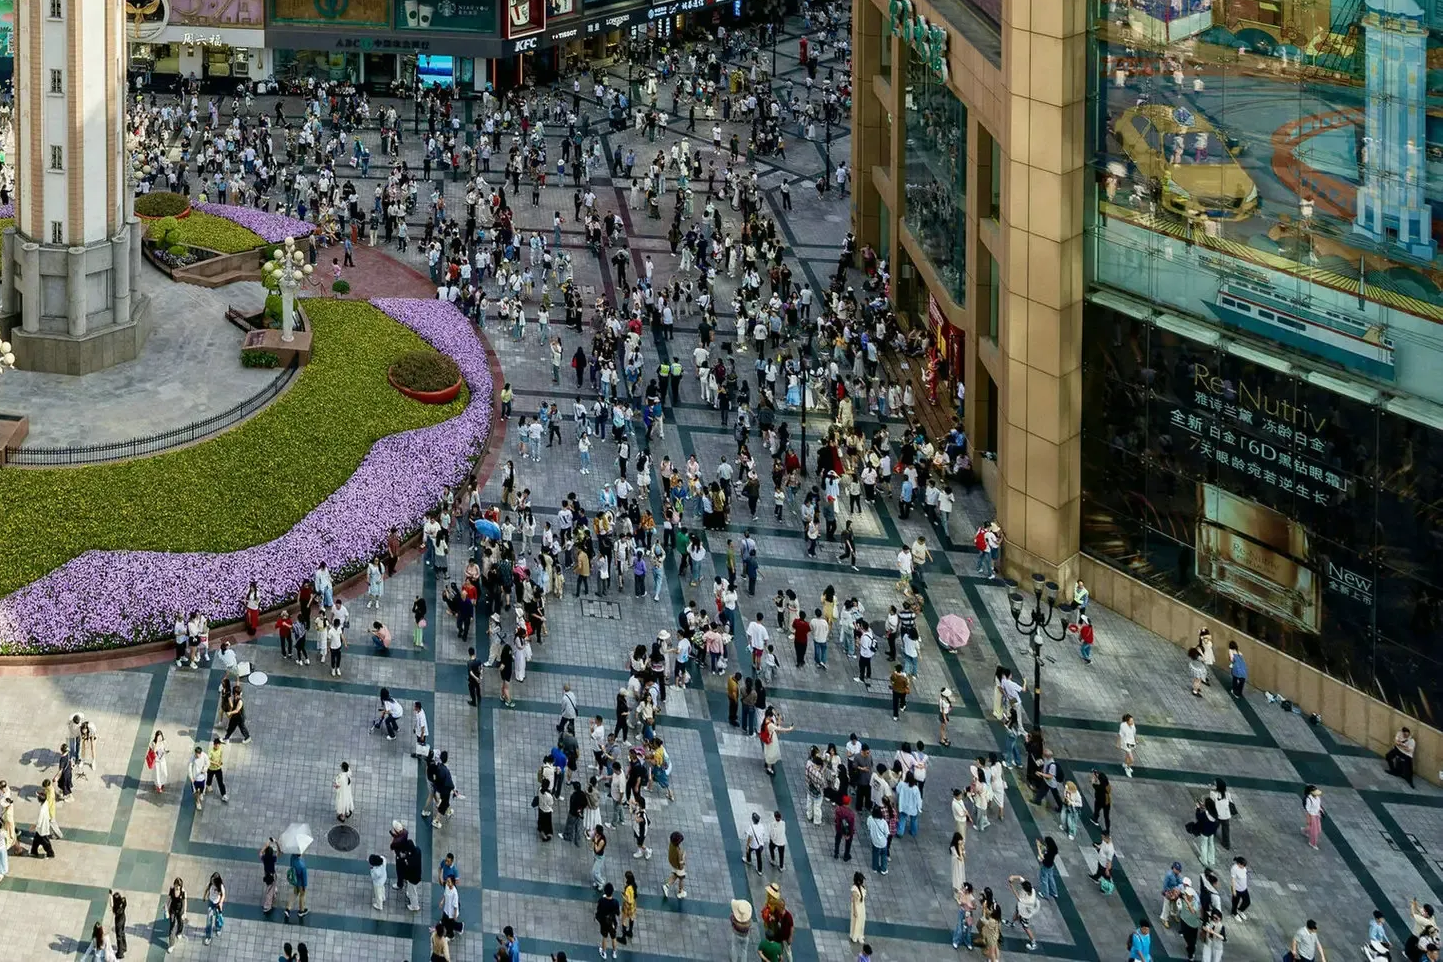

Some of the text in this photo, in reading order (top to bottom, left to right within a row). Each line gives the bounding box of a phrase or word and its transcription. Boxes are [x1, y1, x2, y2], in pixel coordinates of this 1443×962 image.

[606, 14, 630, 26] LONGINES
[182, 33, 222, 46] 周六福
[559, 29, 577, 39] TISSOT
[336, 38, 360, 48] ABC
[514, 38, 537, 52] KFC
[1194, 363, 1326, 433] Re-Nutriv
[1195, 391, 1254, 425] 雅诗兰黛
[1329, 562, 1373, 592] New
[1328, 580, 1373, 606] 全新上市
